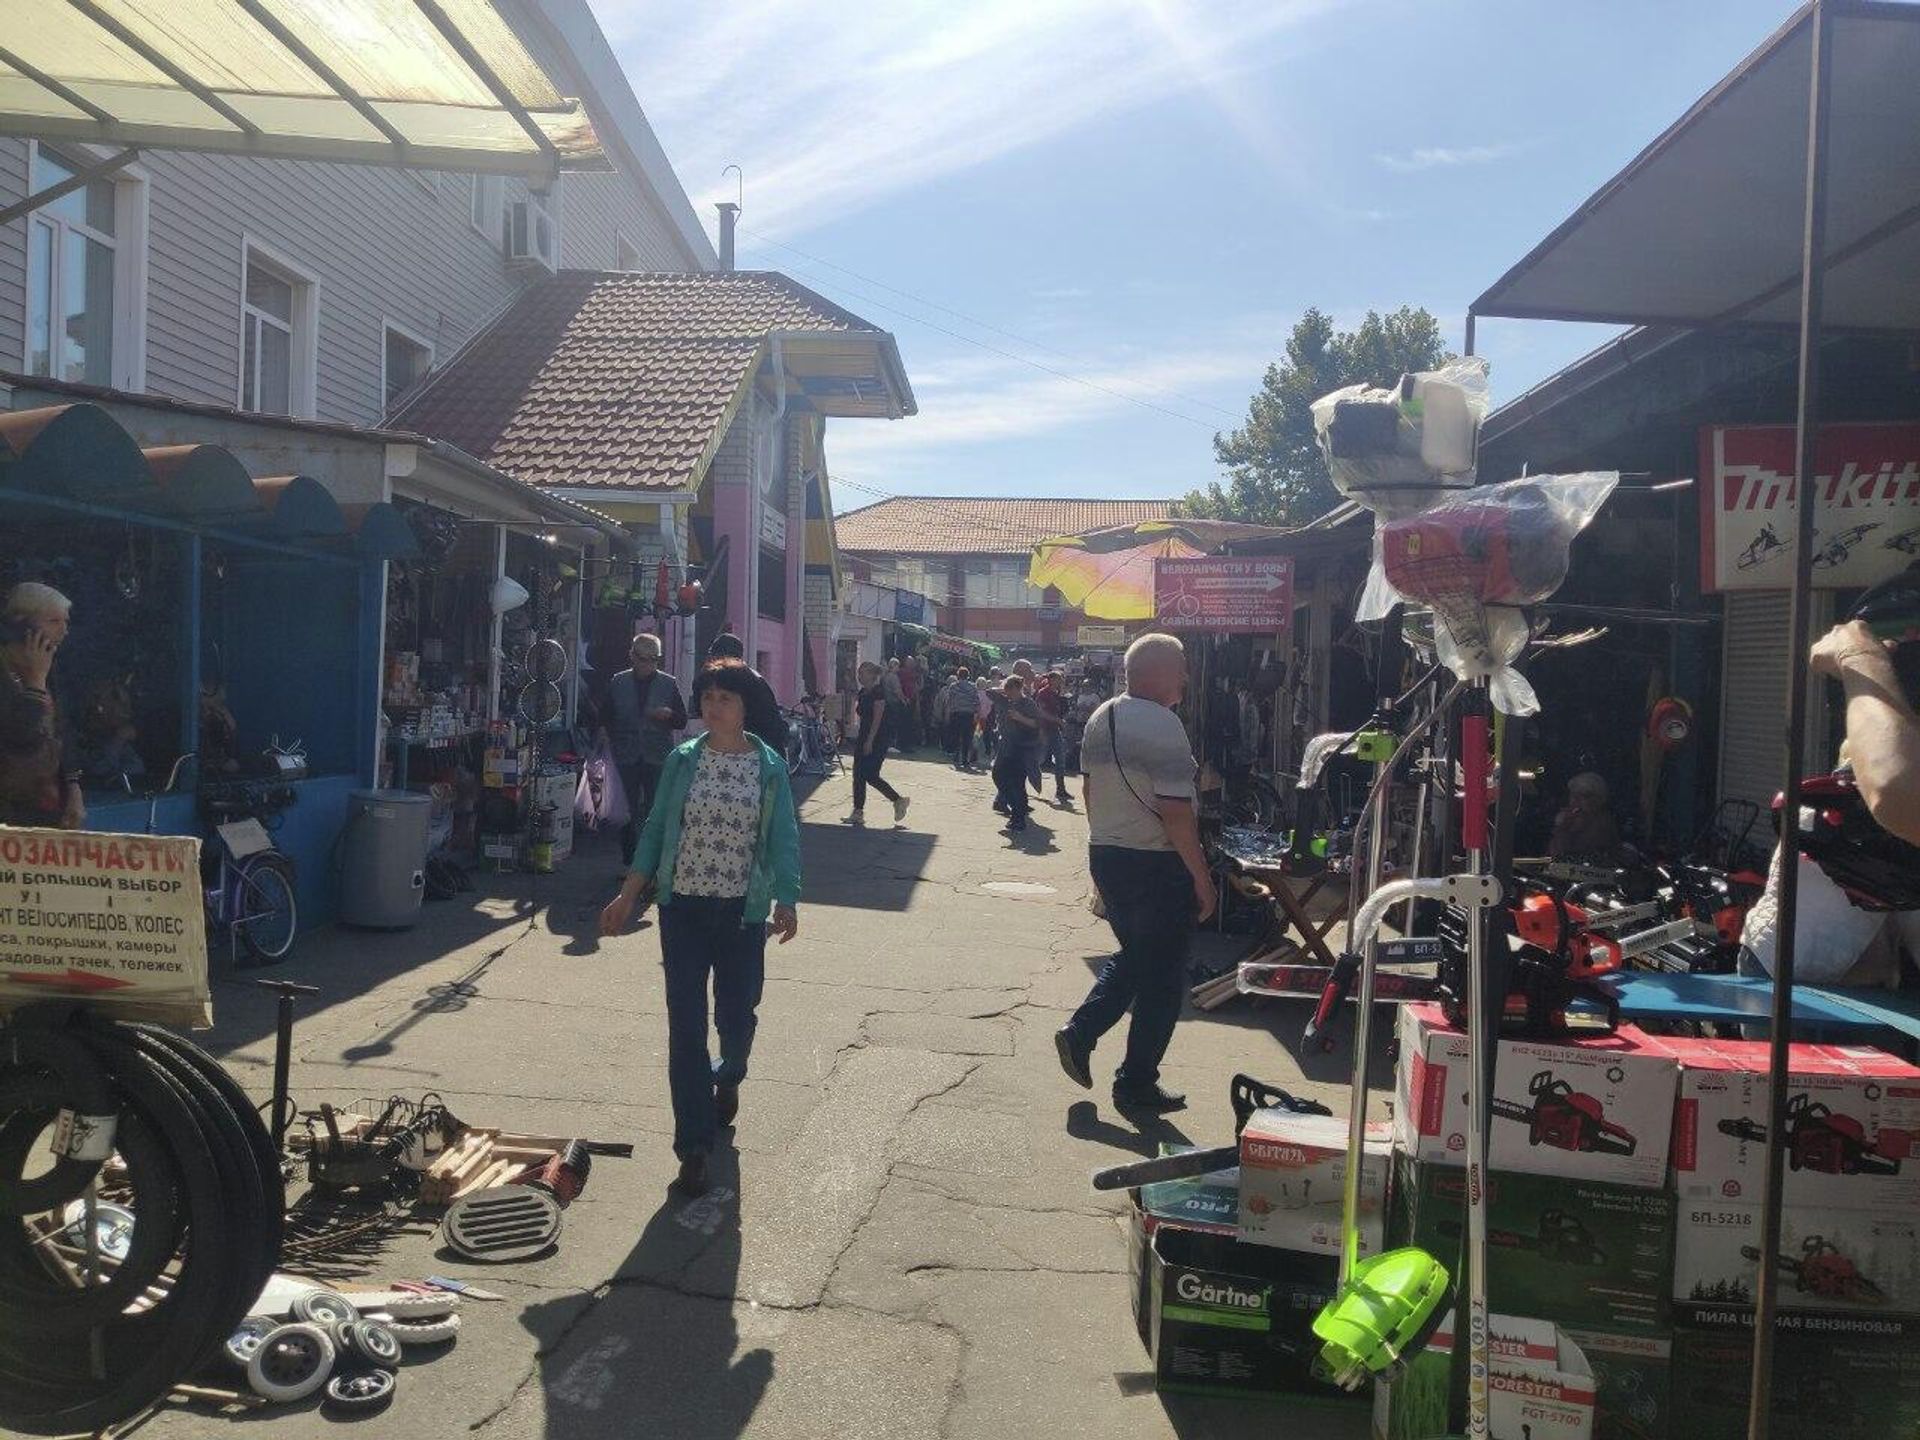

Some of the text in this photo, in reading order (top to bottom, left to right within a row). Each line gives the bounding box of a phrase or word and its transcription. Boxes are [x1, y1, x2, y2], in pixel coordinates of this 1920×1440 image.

[1160, 562, 1287, 575] ВЕЛОЗАПЧАСТИ У ВОВЫ
[1252, 616, 1285, 627] ЦЕНЫ
[22, 872, 113, 889] БОЛЬШОЙ
[117, 877, 182, 893] ВЫБОР
[135, 914, 184, 936] КОЛЕС
[117, 940, 177, 956] камеры
[1691, 1211, 1752, 1226] БП-5218
[1177, 1272, 1273, 1311] Gärtner
[1695, 1310, 1737, 1324] ПИЛА
[1804, 1317, 1903, 1333] БЕНЗИНОВАЯ
